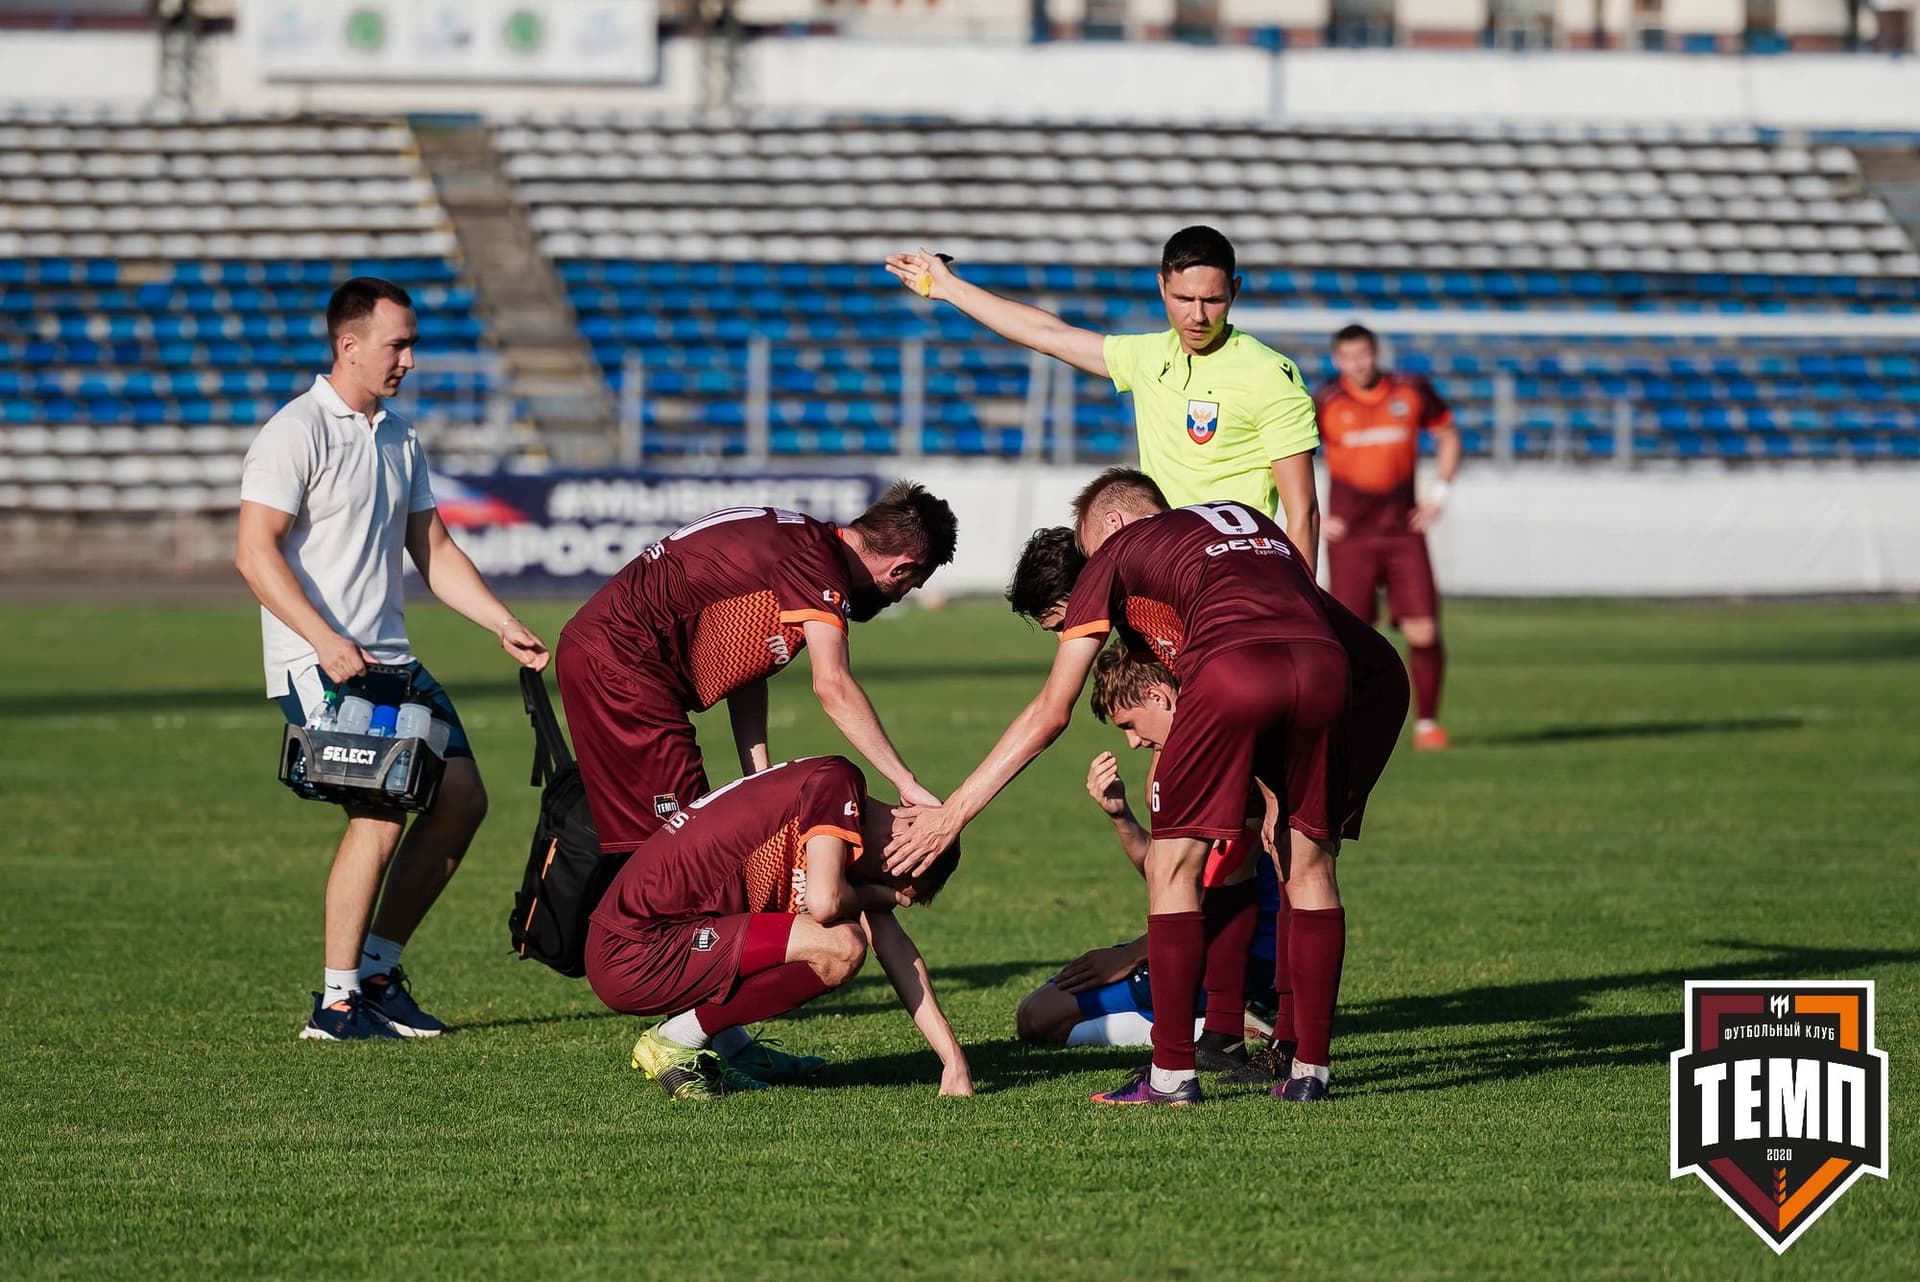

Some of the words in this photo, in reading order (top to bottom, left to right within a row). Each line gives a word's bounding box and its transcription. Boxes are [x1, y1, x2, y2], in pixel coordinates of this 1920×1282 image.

[322, 745, 377, 766] SELECT
[1151, 781, 1161, 812] 6
[657, 801, 677, 814] ТЕМП
